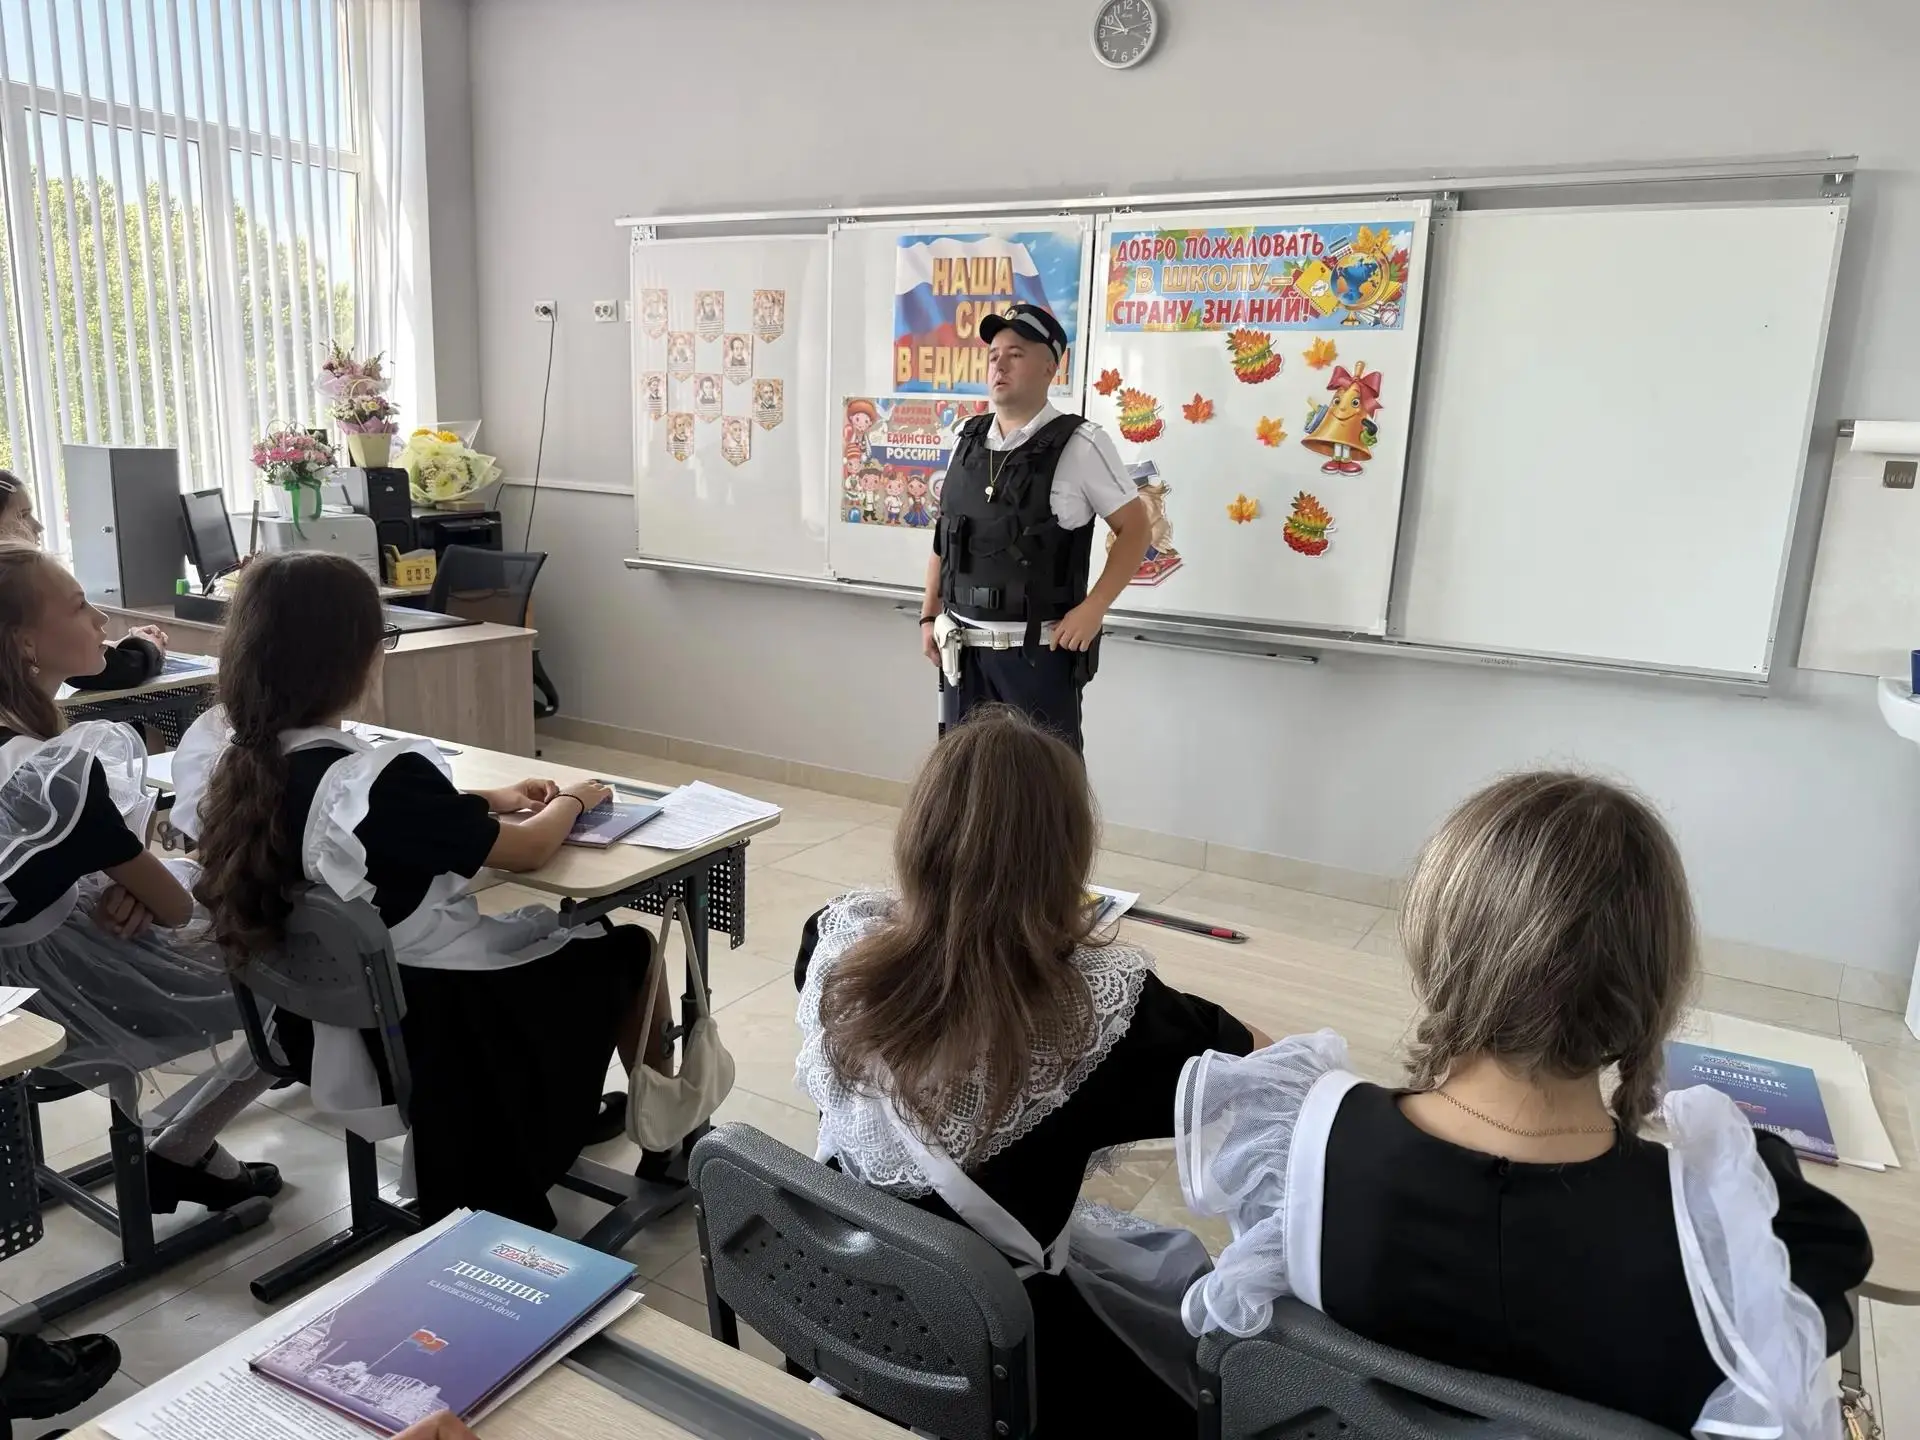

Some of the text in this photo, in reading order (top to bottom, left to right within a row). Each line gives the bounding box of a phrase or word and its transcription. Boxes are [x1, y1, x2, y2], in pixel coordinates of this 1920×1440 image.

[1123, 0, 1133, 10] 12
[1104, 15, 1114, 26] 10
[1142, 9, 1149, 20] 2
[1099, 28, 1106, 38] 9
[1145, 22, 1153, 34] 3
[1102, 41, 1109, 52] 8
[1132, 47, 1139, 58] 5
[1111, 49, 1117, 60] 7
[1121, 51, 1128, 62] 6
[1116, 232, 1325, 262] ДОБРО ПОЖАЛОВАТЬ
[932, 256, 1014, 296] НАША
[1135, 267, 1154, 294] В
[1113, 290, 1312, 325] СТРАНУ ЗНАНИЙ!
[896, 346, 912, 384] В
[887, 432, 941, 445] ЕДИНСТВО
[886, 447, 941, 461] РОССИИ!
[443, 1260, 550, 1305] ДНЕВНИК
[455, 1280, 512, 1306] ШКОЛЬНИКА
[427, 1280, 520, 1321] КАНЕВСКОГО РАЙОНА
